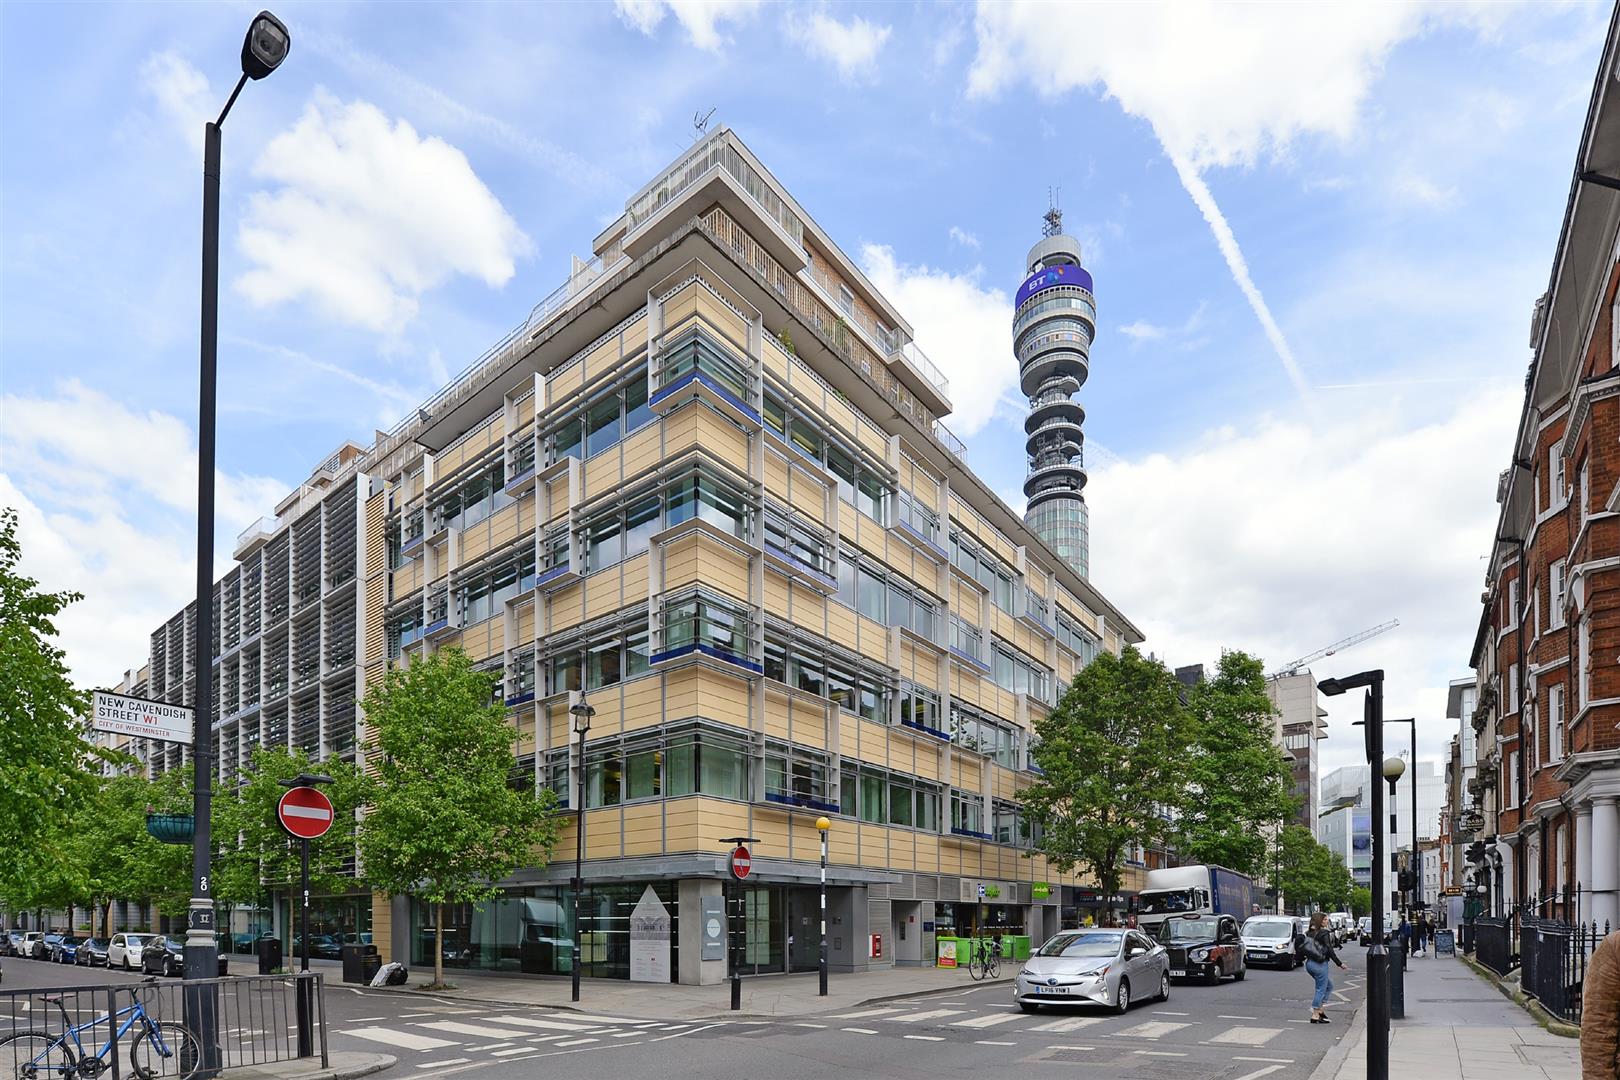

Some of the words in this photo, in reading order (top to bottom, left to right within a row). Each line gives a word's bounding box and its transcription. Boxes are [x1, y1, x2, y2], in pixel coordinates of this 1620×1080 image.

[1028, 275, 1046, 291] BT
[98, 707, 139, 722] STREET
[143, 714, 158, 726] W1
[99, 696, 125, 709] NEW
[128, 701, 186, 720] CAVENDISH
[98, 720, 113, 728] CITY
[125, 724, 170, 737] WESTMINSTER
[200, 876, 208, 891] 20
